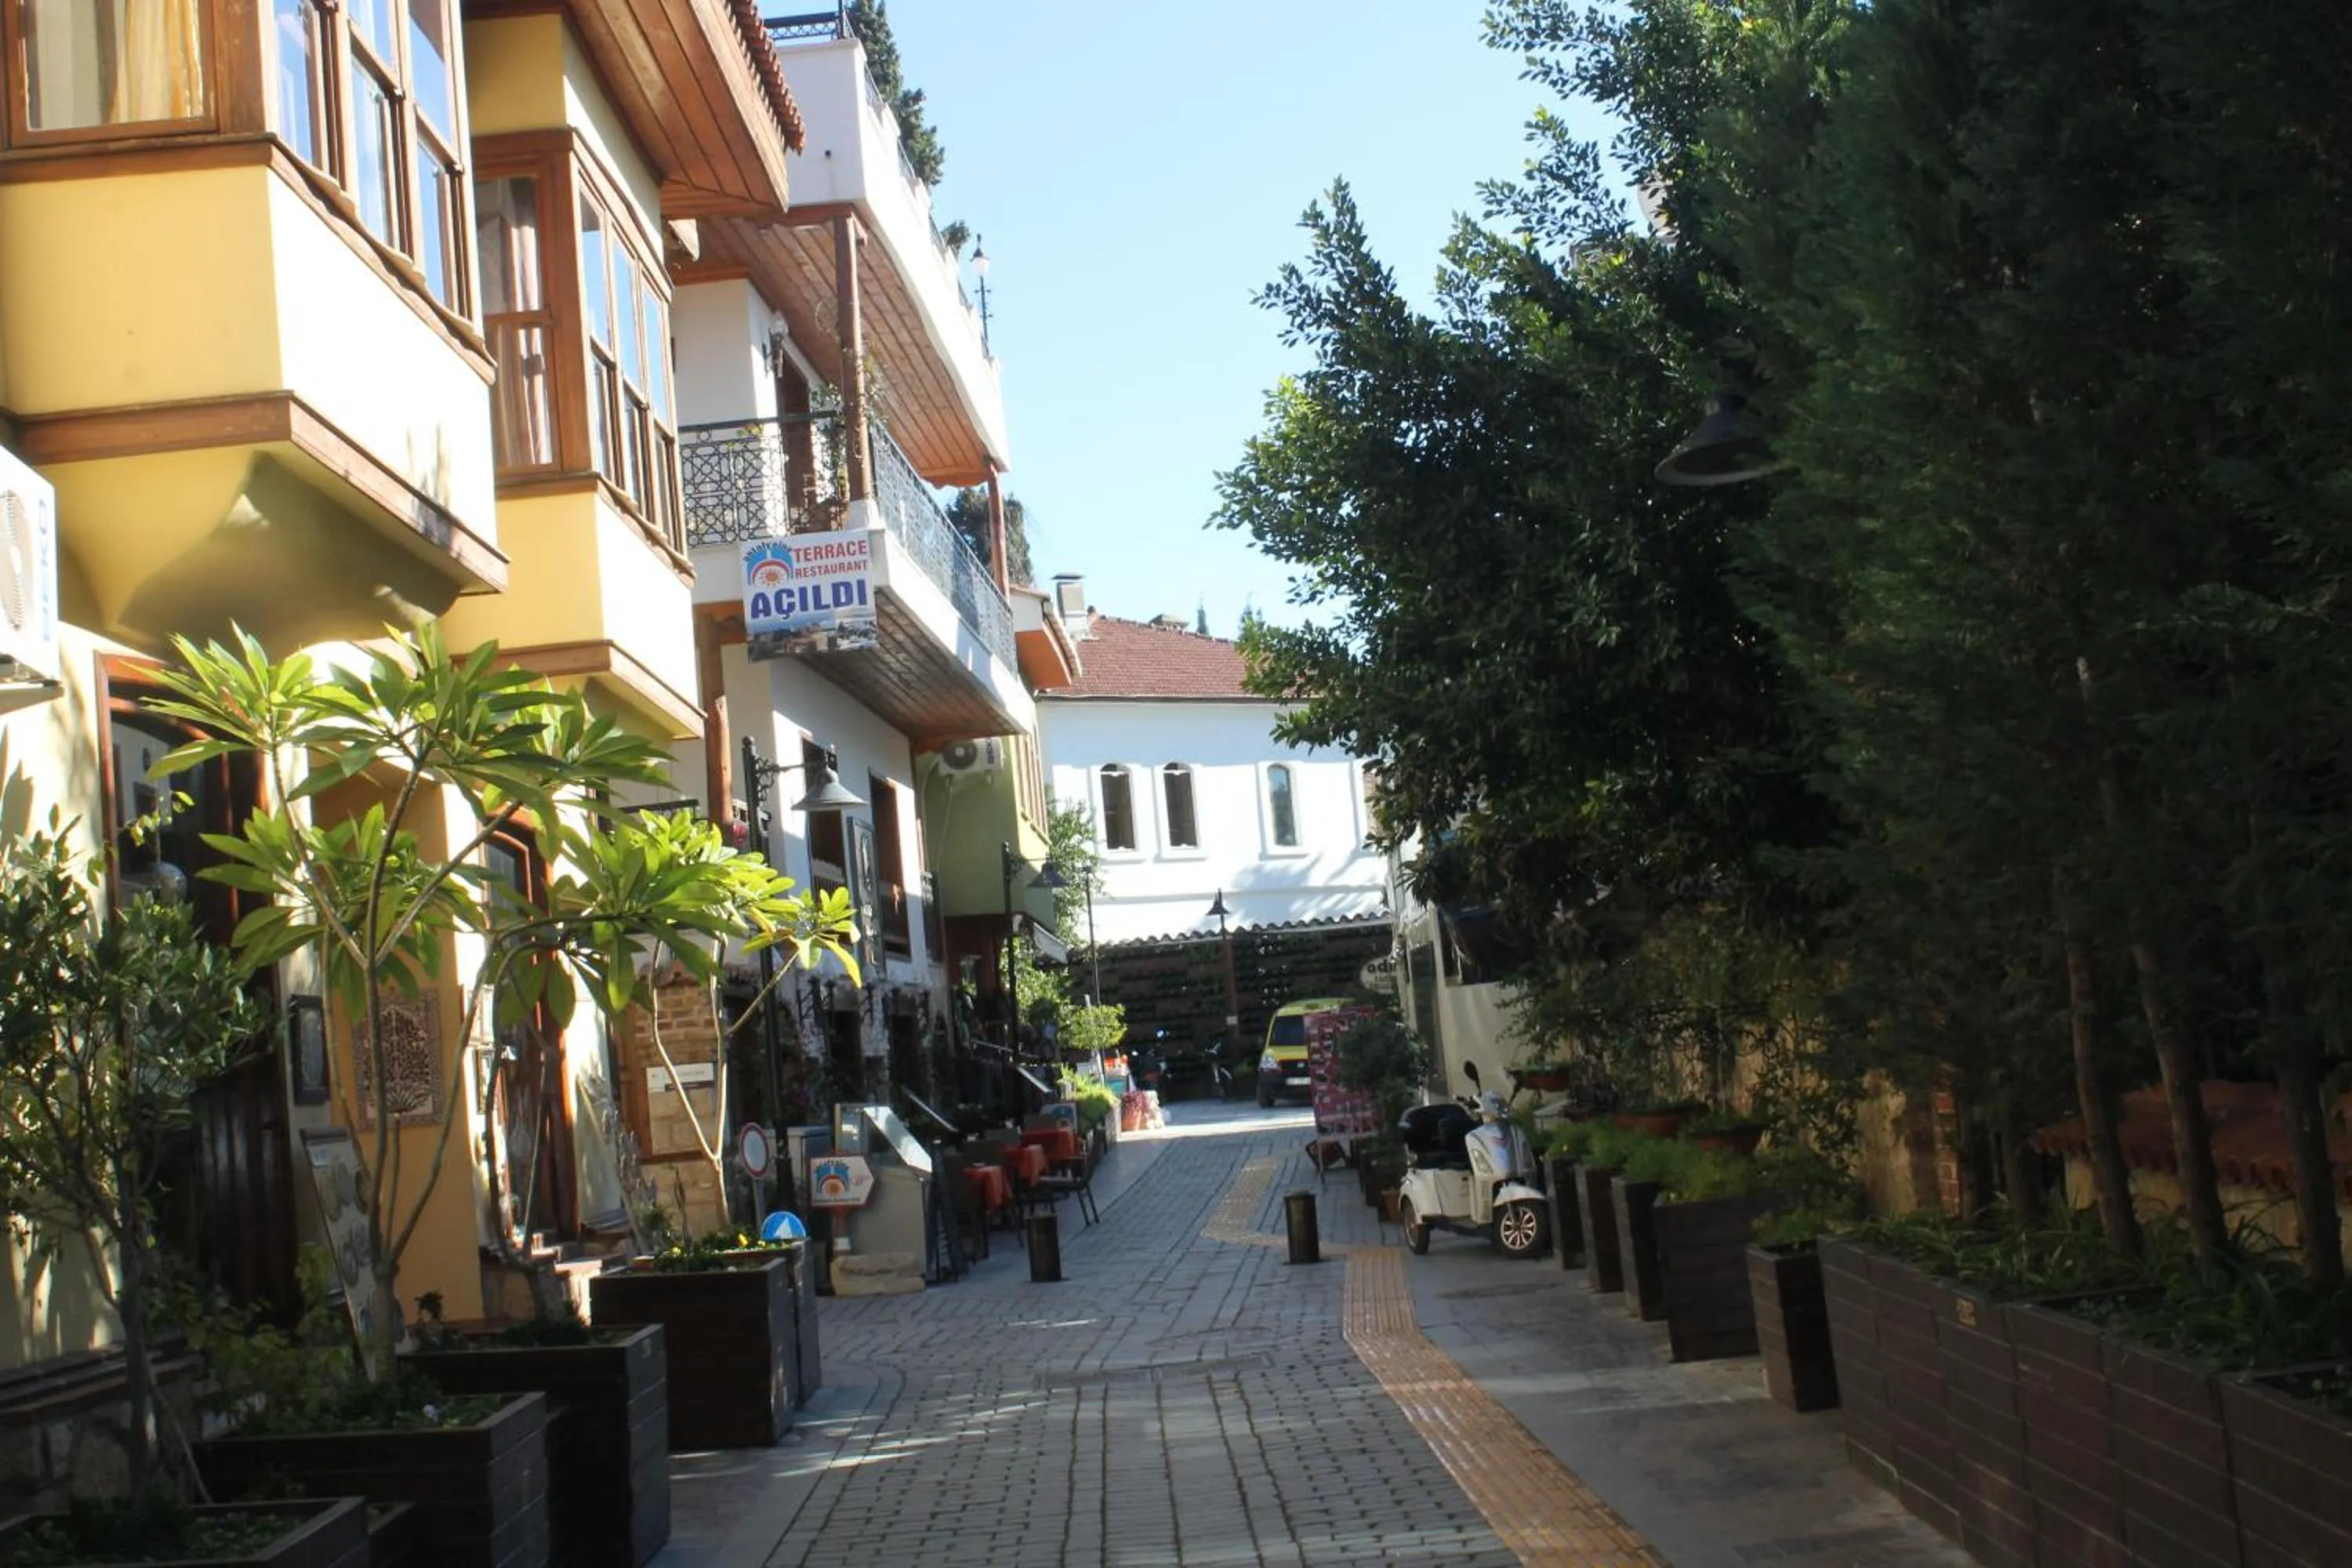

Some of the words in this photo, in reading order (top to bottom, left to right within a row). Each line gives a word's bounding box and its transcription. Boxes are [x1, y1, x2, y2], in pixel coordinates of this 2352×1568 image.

[793, 540, 868, 562] TERRACE
[795, 560, 868, 579] RESTAURANT
[750, 579, 867, 619] AÇILDI
